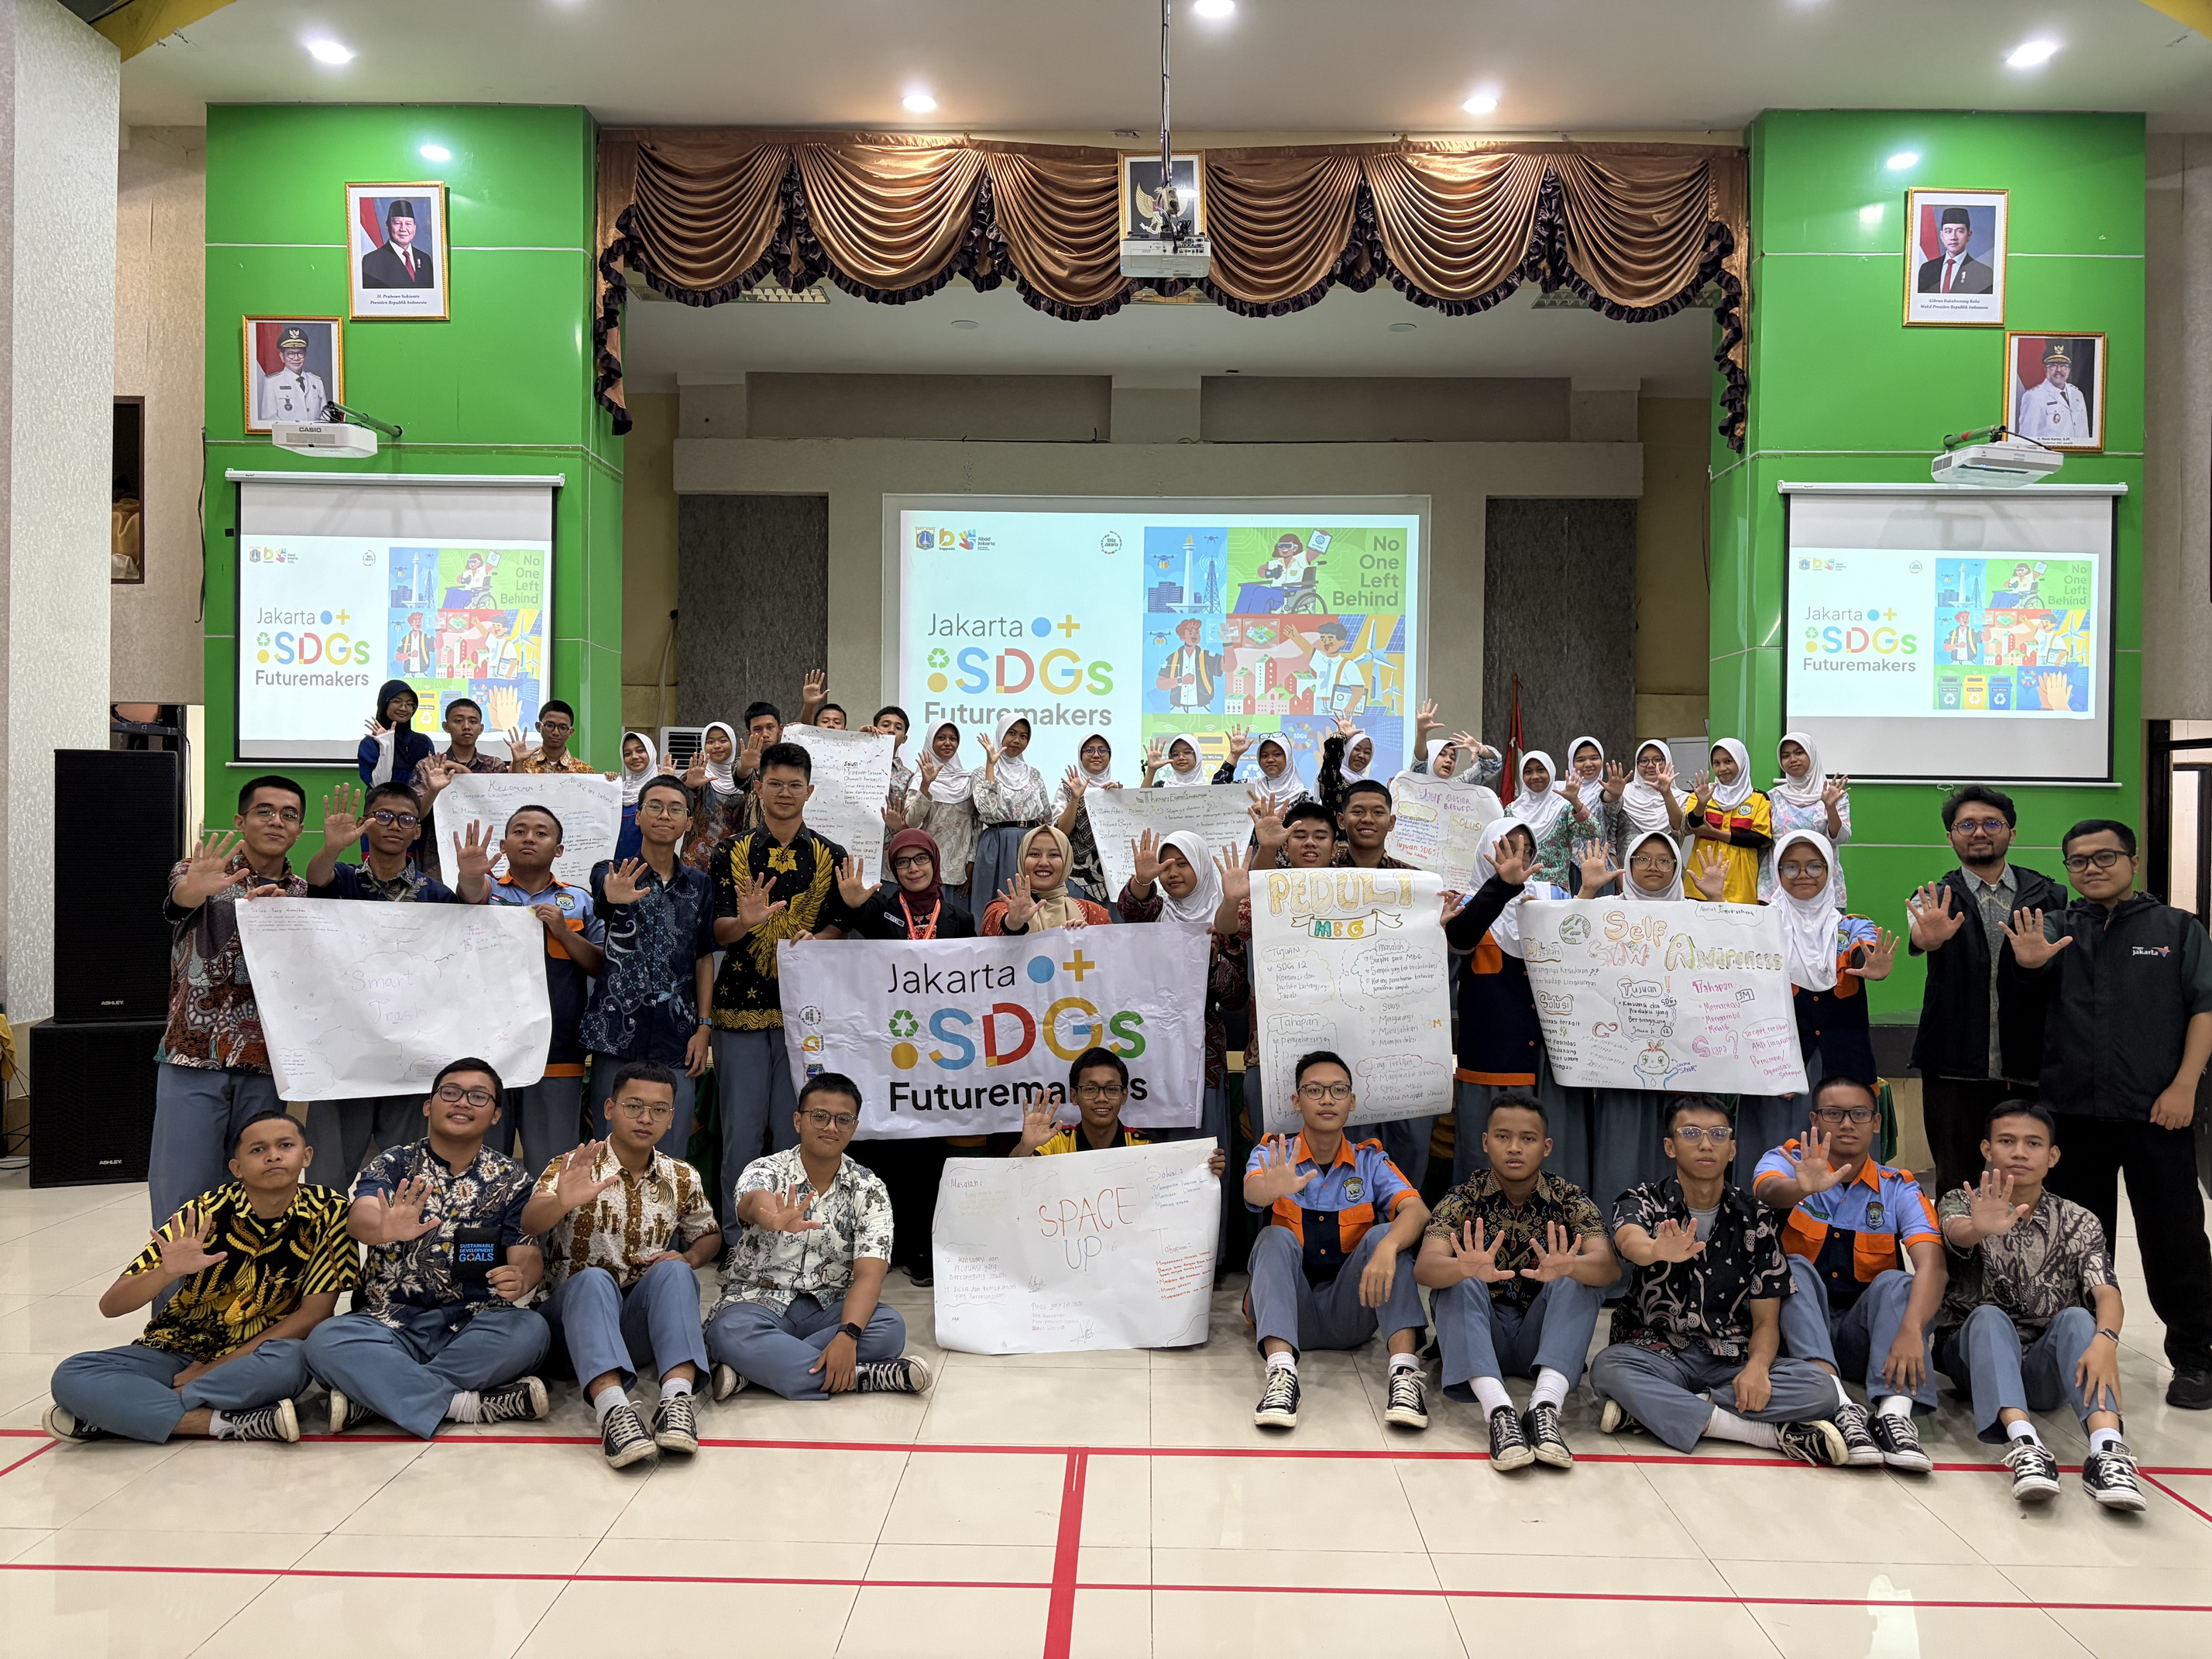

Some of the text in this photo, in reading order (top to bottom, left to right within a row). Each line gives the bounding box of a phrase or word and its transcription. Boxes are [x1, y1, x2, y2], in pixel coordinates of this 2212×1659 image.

[1373, 536, 1400, 551] No
[524, 555, 541, 566] No
[1360, 555, 1399, 570] One
[516, 568, 540, 579] One
[2072, 565, 2087, 574] No
[516, 580, 540, 592] Left
[1361, 572, 1399, 589] Left
[2064, 575, 2087, 585] One
[500, 592, 539, 604] Behind
[1333, 590, 1399, 607] Behind
[2065, 586, 2087, 595] Left
[2048, 596, 2087, 605] Behind
[257, 607, 316, 625] Jakarta
[1805, 606, 1863, 621] Jakarta
[927, 613, 1024, 637] Jakarta
[274, 630, 370, 665] SDGs
[1822, 627, 1917, 654] SDGs
[955, 647, 1114, 696] SDGs
[1803, 658, 1916, 672] Futuremakers
[256, 670, 369, 687] Futuremakers
[1268, 872, 1413, 915] PEDULI
[1314, 920, 1365, 938] MBG
[1605, 910, 1668, 948] Self
[1297, 960, 1307, 970] 12
[352, 970, 414, 992] Smart
[888, 963, 1016, 994] Jakarta
[1692, 979, 1734, 994] Tahapan
[1620, 982, 1657, 997] Tujuan
[1737, 991, 1751, 1001] 3M
[1539, 994, 1570, 1010] Solusi
[368, 998, 428, 1025] Trash
[1273, 1015, 1319, 1033] Tahapan
[1427, 1018, 1442, 1030] 3M
[928, 996, 1146, 1070] SDGs
[889, 1077, 1148, 1112] Futuremas
[1039, 1187, 1136, 1237] SPACE
[459, 1252, 494, 1262] GOALS
[1064, 1235, 1102, 1273] UP
